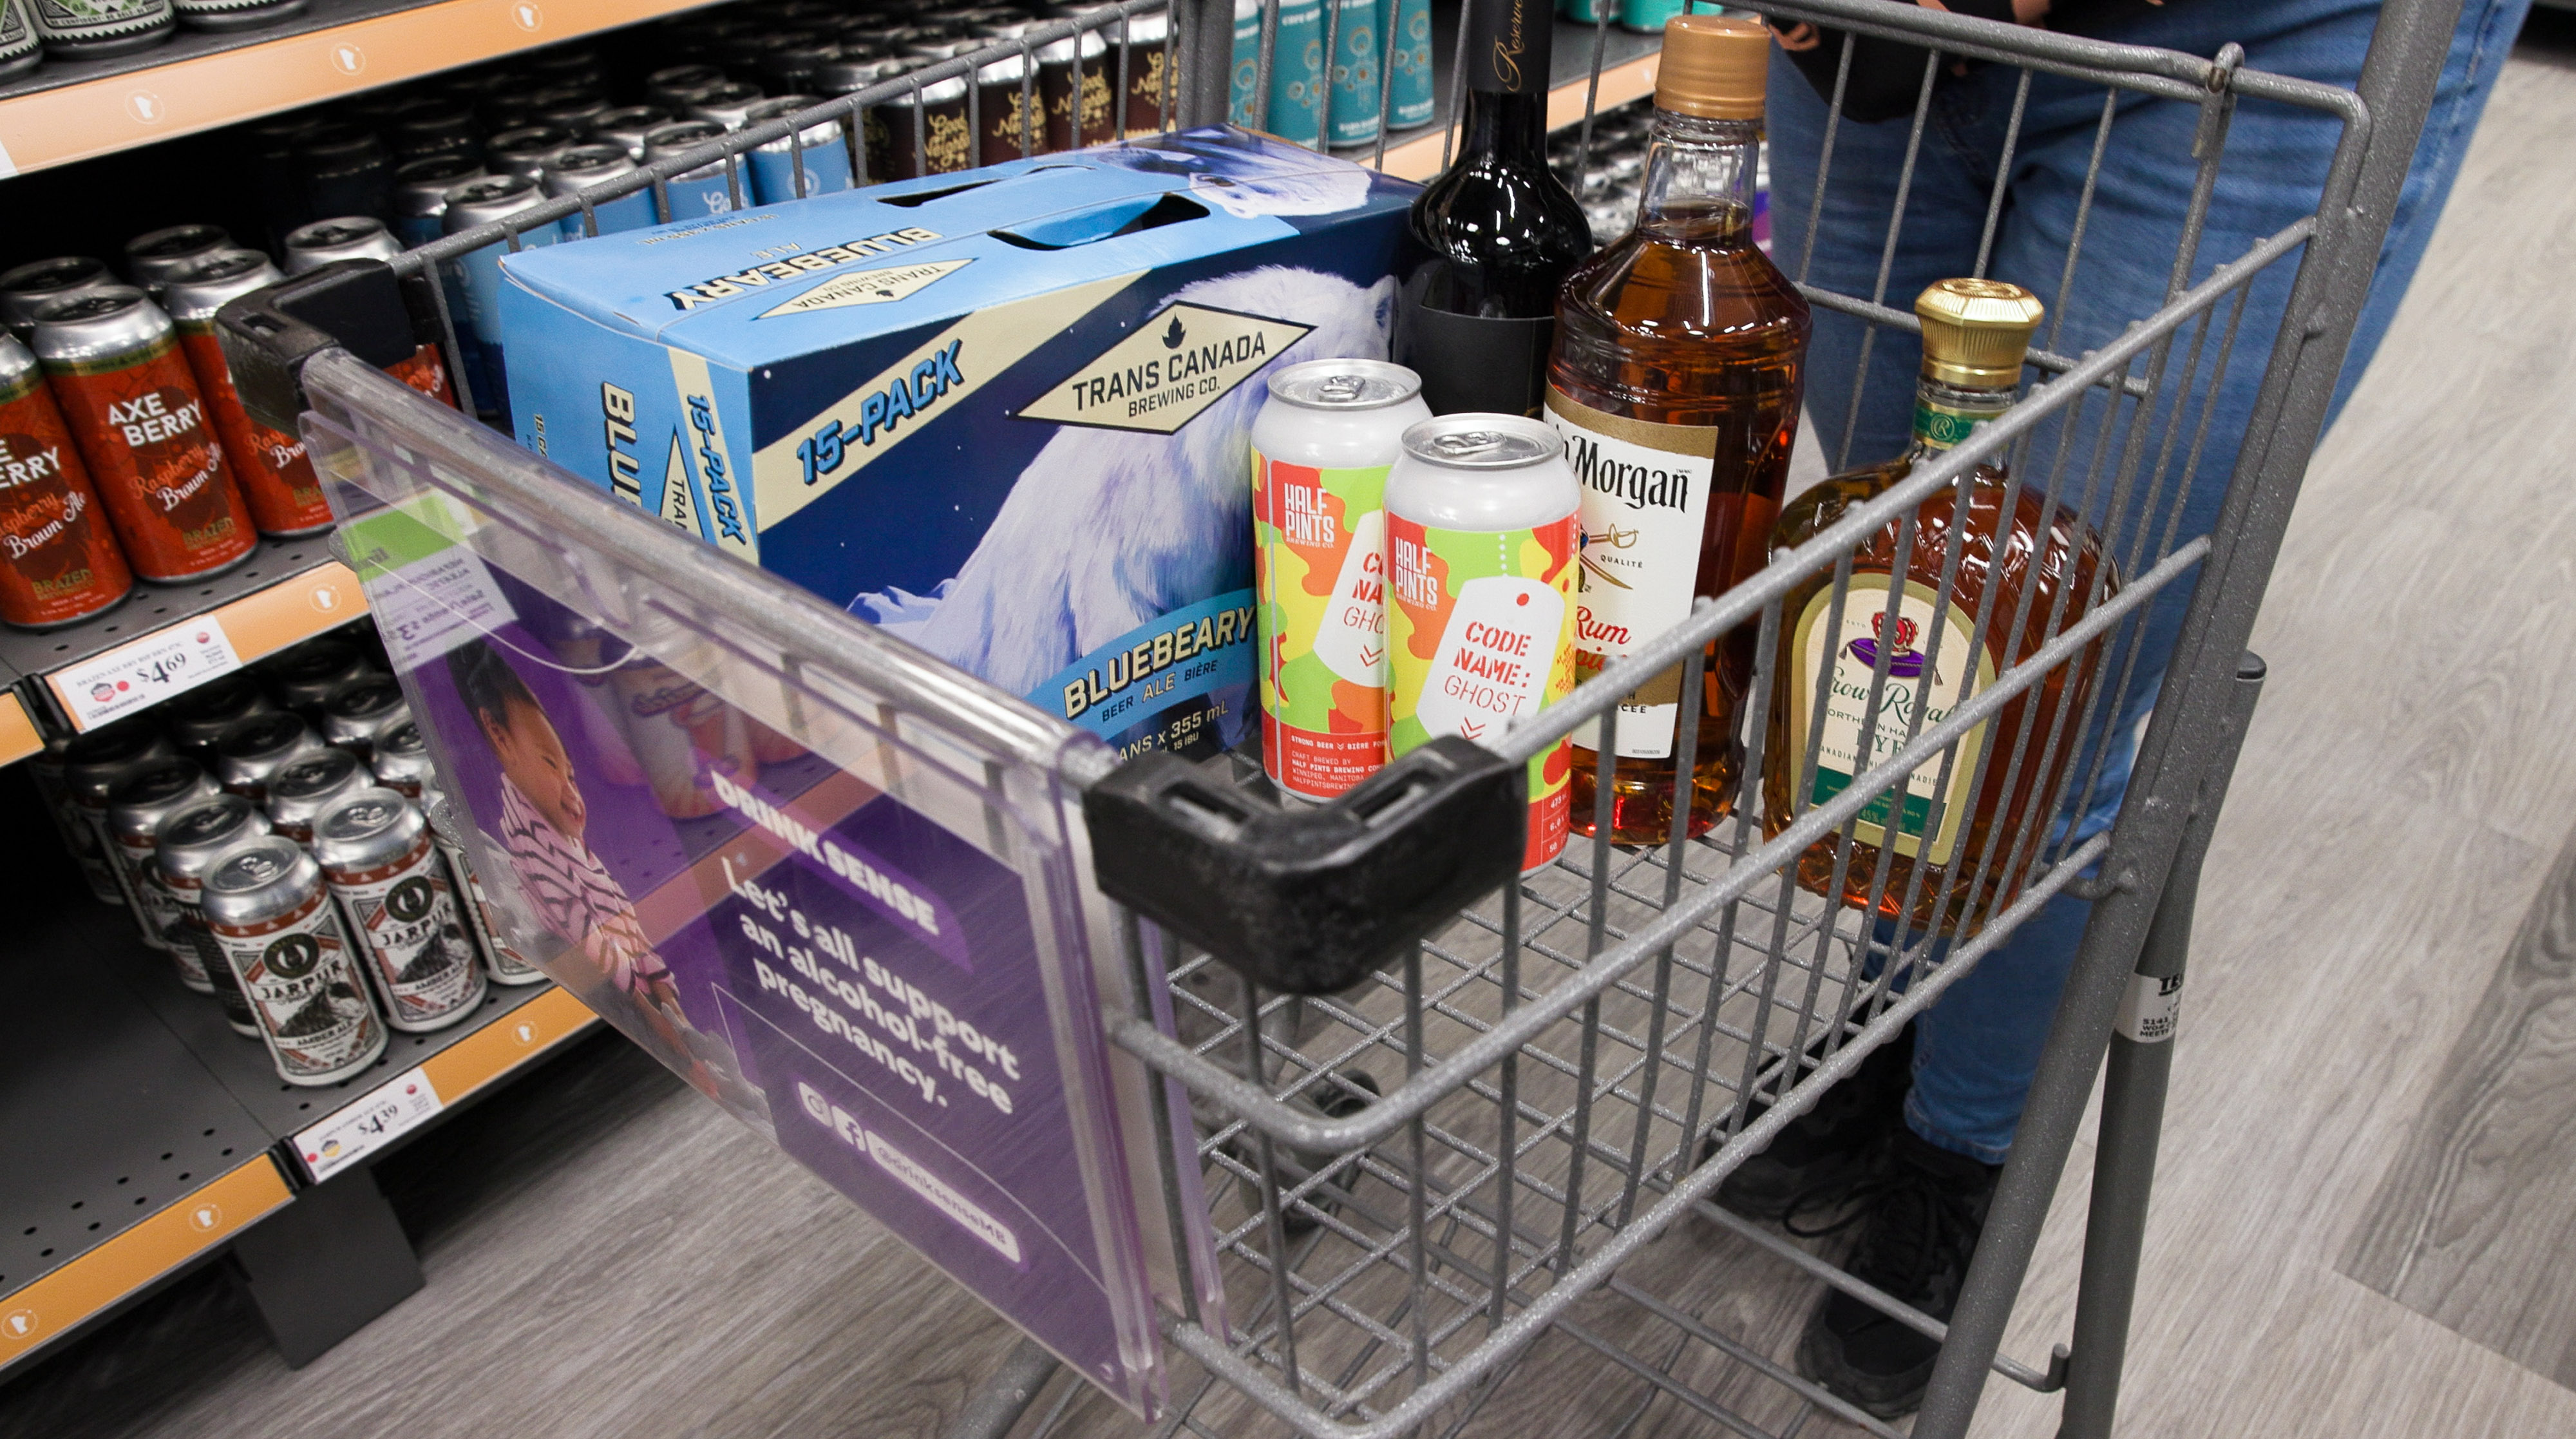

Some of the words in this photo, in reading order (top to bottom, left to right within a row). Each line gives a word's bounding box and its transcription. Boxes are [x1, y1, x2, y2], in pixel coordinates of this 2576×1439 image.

[1493, 0, 1525, 92] Reserve
[664, 227, 945, 311] BLUEBEARY
[751, 242, 804, 259] ALE
[790, 282, 878, 309] CANADA
[879, 265, 946, 287] TRANS
[1072, 361, 1160, 412] TRANS
[1167, 330, 1267, 380] CANADA
[108, 392, 167, 426] AXE
[796, 339, 965, 485] 15-PACK
[1128, 386, 1195, 418] BREWING
[1199, 378, 1221, 395] CO.
[122, 397, 204, 447] BERRY
[129, 443, 211, 501] Raspberry
[269, 440, 305, 469] Bro
[687, 394, 746, 545] 15-PACK
[1572, 435, 1690, 514] Morgan
[156, 468, 209, 513] Brown
[1284, 482, 1328, 515] HALF
[3, 517, 64, 560] Brown
[1285, 510, 1335, 544] PINTS
[1285, 536, 1320, 548] BREWING
[1395, 536, 1432, 575] HALF
[1600, 553, 1643, 568] QUALITÉ
[1396, 564, 1439, 607] PINTS
[1464, 621, 1531, 657] CODE
[1575, 605, 1632, 645] Rum
[1063, 604, 1256, 720] BLUEBEARY
[1453, 647, 1531, 688] NAME:
[1102, 695, 1134, 723] BEER
[1141, 672, 1176, 703] ALE
[1184, 659, 1218, 681] BIÈRE
[1444, 674, 1526, 716] GHOST
[1880, 683, 1956, 727] Roal
[1119, 734, 1153, 761] ANS
[1157, 732, 1166, 745] x
[1170, 716, 1202, 739] 355
[1206, 700, 1229, 723] mL
[1291, 735, 1314, 747] STRONG
[1316, 741, 1334, 750] BEER
[1347, 741, 1369, 750] BIÈRE
[1292, 750, 1311, 761] CRAFT
[1313, 756, 1340, 765] BREWED
[1292, 758, 1307, 768] HALF
[1309, 763, 1331, 773] PINTS
[711, 770, 825, 864] DRINK
[823, 841, 939, 935] SENSE
[739, 915, 784, 960] an
[788, 946, 1013, 1114] alcohol-free
[813, 926, 860, 971] all
[863, 957, 1020, 1080] support
[753, 958, 947, 1107] pregnancy.
